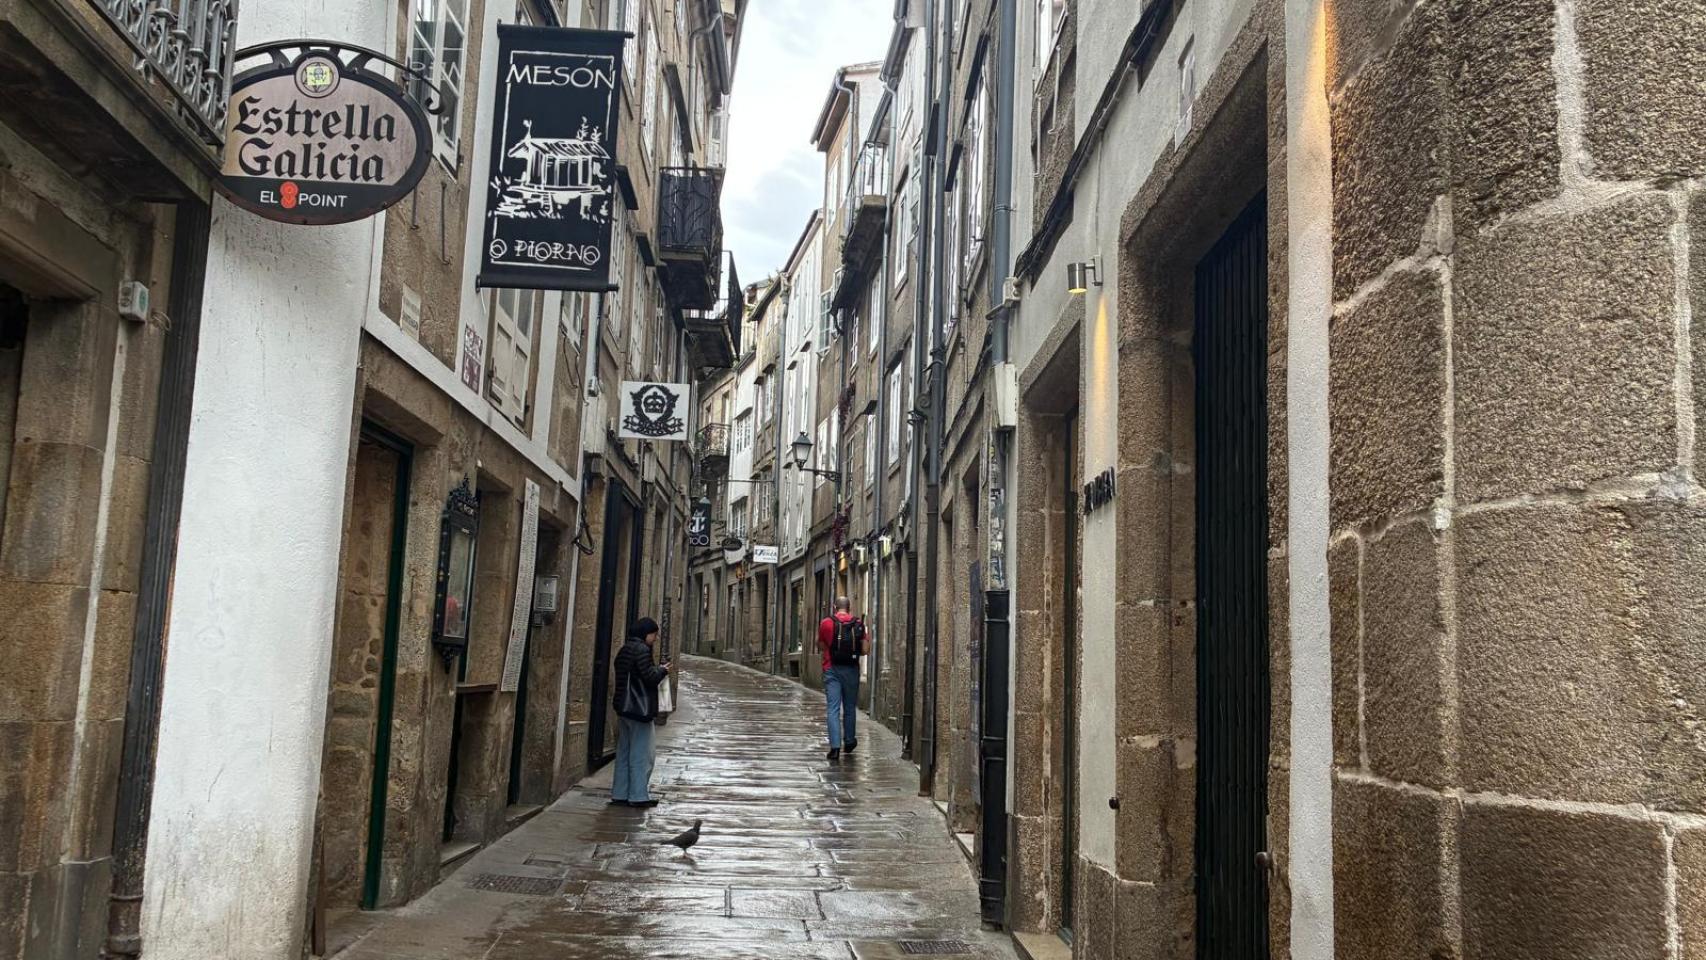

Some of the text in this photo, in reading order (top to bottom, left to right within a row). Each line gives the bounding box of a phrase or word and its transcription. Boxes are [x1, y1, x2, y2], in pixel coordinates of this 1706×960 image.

[505, 59, 616, 90] MESÓN
[232, 95, 397, 142] Estrella
[238, 137, 384, 183] Galicia
[260, 190, 279, 204] EL
[298, 193, 348, 208] POINT
[489, 238, 601, 265] O PIORNO
